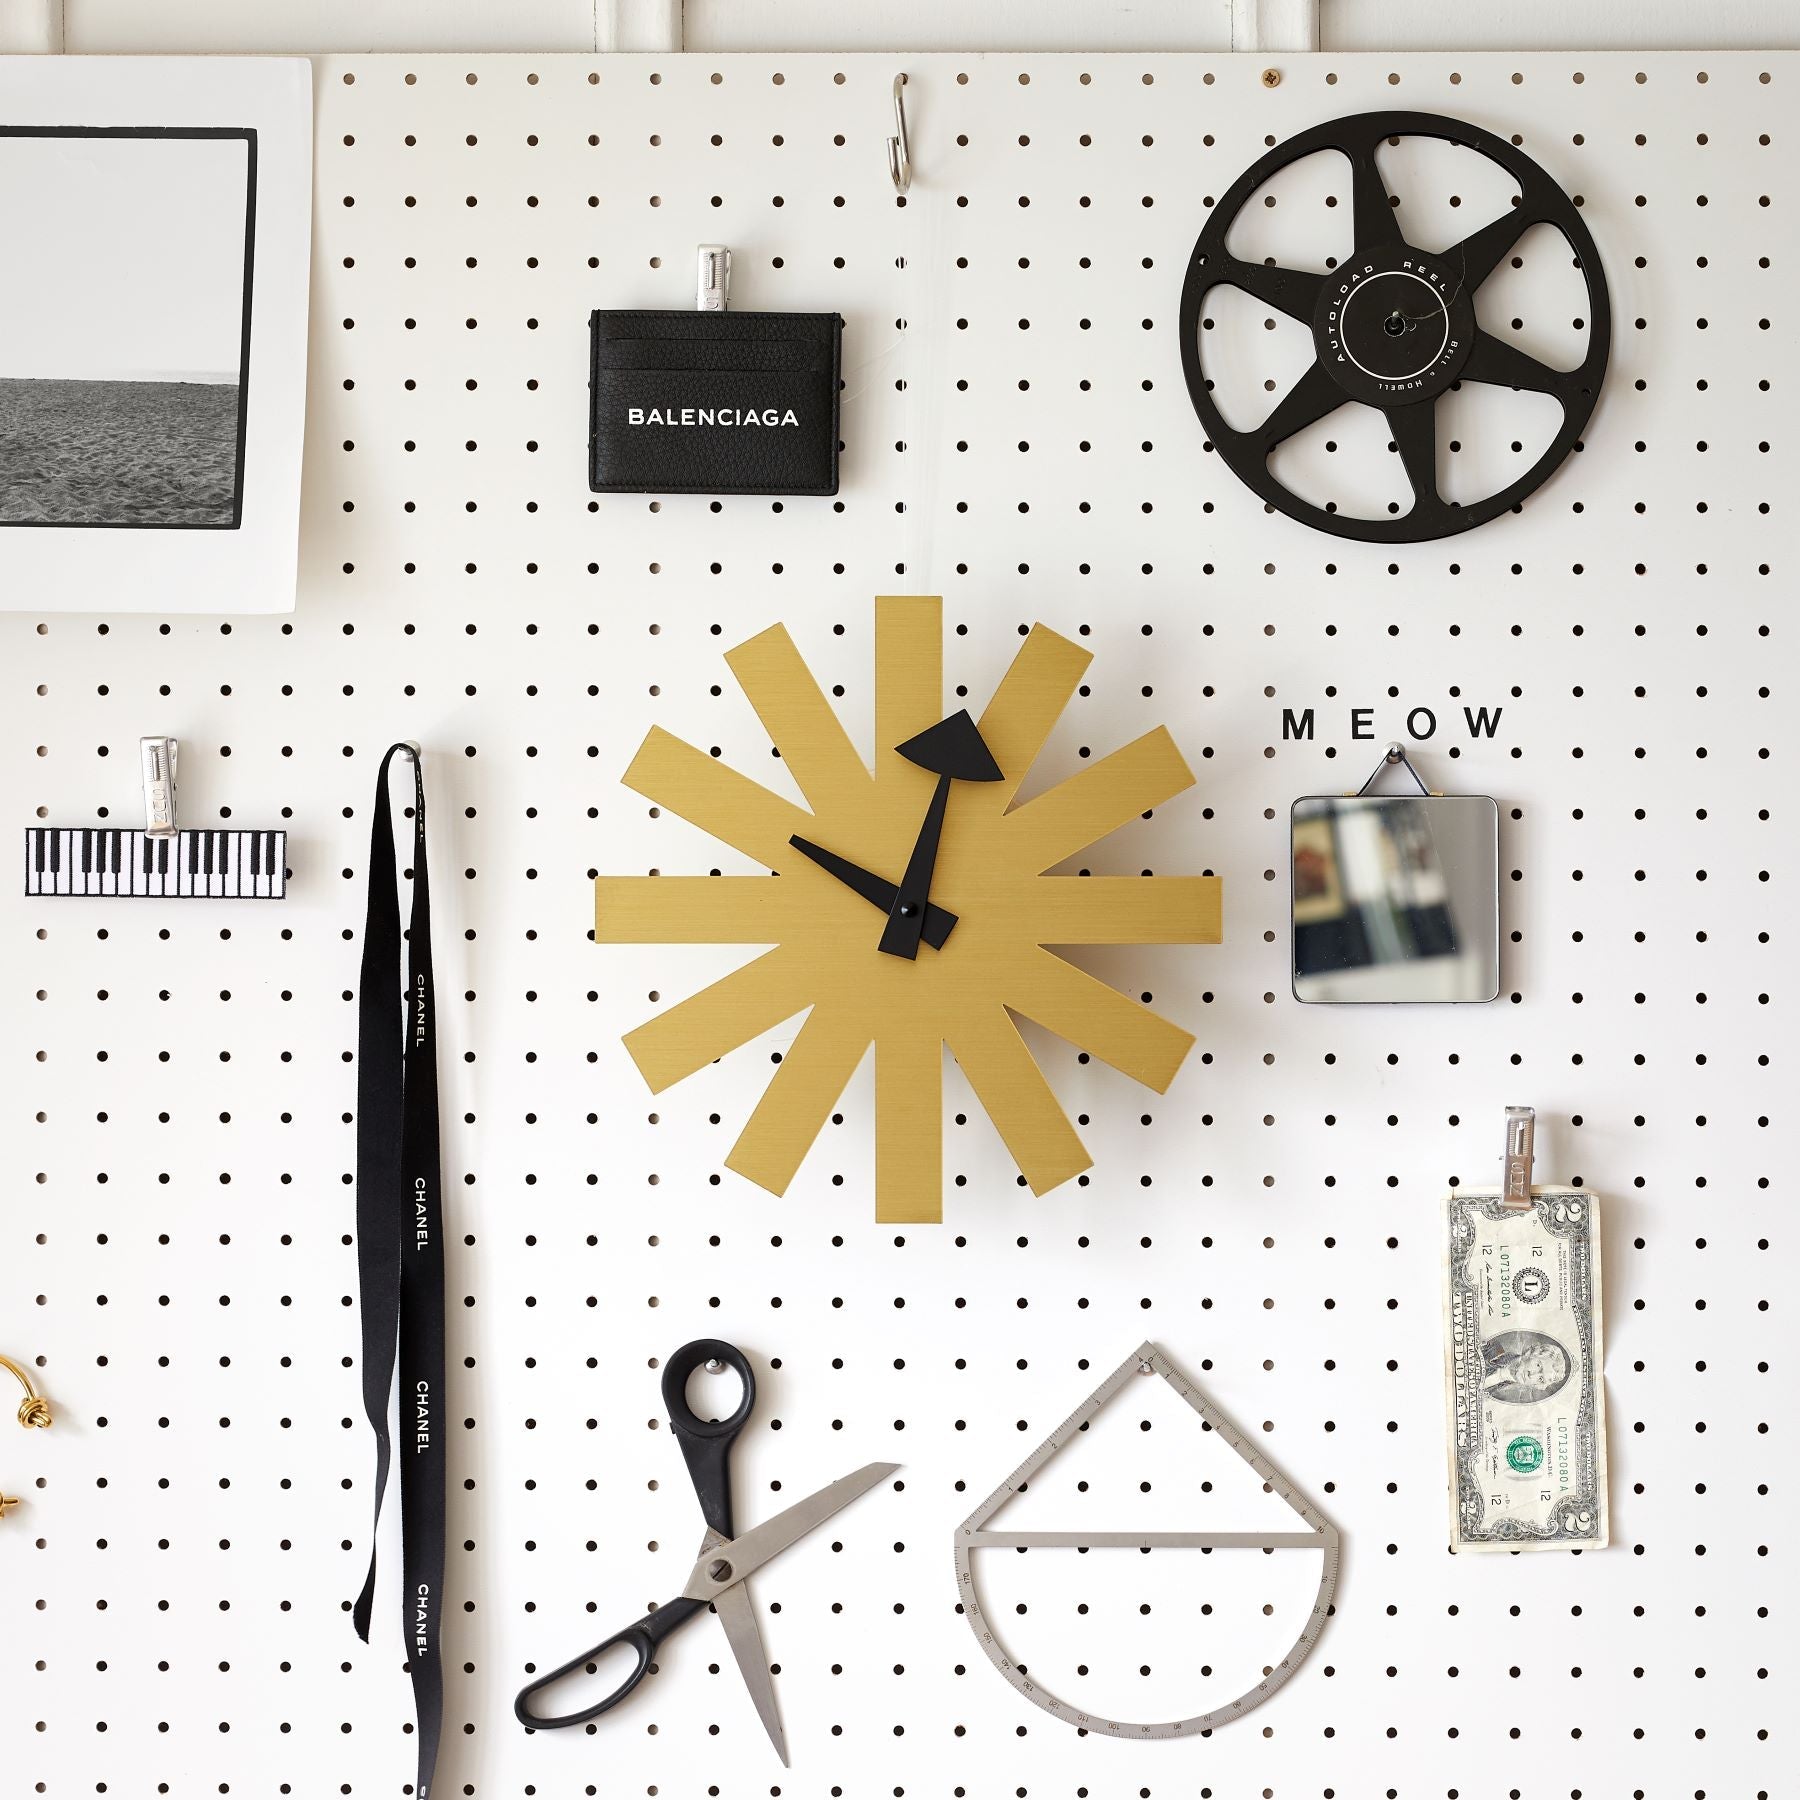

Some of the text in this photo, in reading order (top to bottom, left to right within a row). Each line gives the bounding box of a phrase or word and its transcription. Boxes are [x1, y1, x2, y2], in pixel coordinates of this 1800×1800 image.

[1328, 261, 1446, 362] AUTOLOAD REEL
[1440, 340, 1458, 365] BELL
[1378, 380, 1422, 390] HOWELL
[628, 408, 799, 427] BALENCIAGA
[1282, 706, 1502, 740] MEOW
[416, 974, 425, 1048] CHANEL
[415, 1177, 428, 1251] CHANEL
[1555, 1202, 1582, 1223] 2
[1482, 1244, 1492, 1255] 12
[1532, 1246, 1542, 1257] 12
[1524, 1281, 1538, 1292] L
[1466, 1292, 1474, 1336] UNITED
[1468, 1336, 1476, 1380] STATES
[1452, 1292, 1467, 1447] TWO DOLLARS
[416, 1380, 430, 1454] CHANEL
[1470, 1396, 1478, 1447] AMERICA
[1492, 1494, 1502, 1505] 12
[1541, 1490, 1551, 1501] 12
[1564, 1512, 1590, 1532] 2
[971, 1604, 980, 1615] 160
[416, 1584, 429, 1657] CHANEL
[984, 1632, 992, 1643] 150
[1300, 1634, 1307, 1643] 30
[1001, 1659, 1011, 1669] 140
[1282, 1660, 1289, 1668] 40
[1024, 1681, 1033, 1692] 130
[1049, 1700, 1059, 1709] 120
